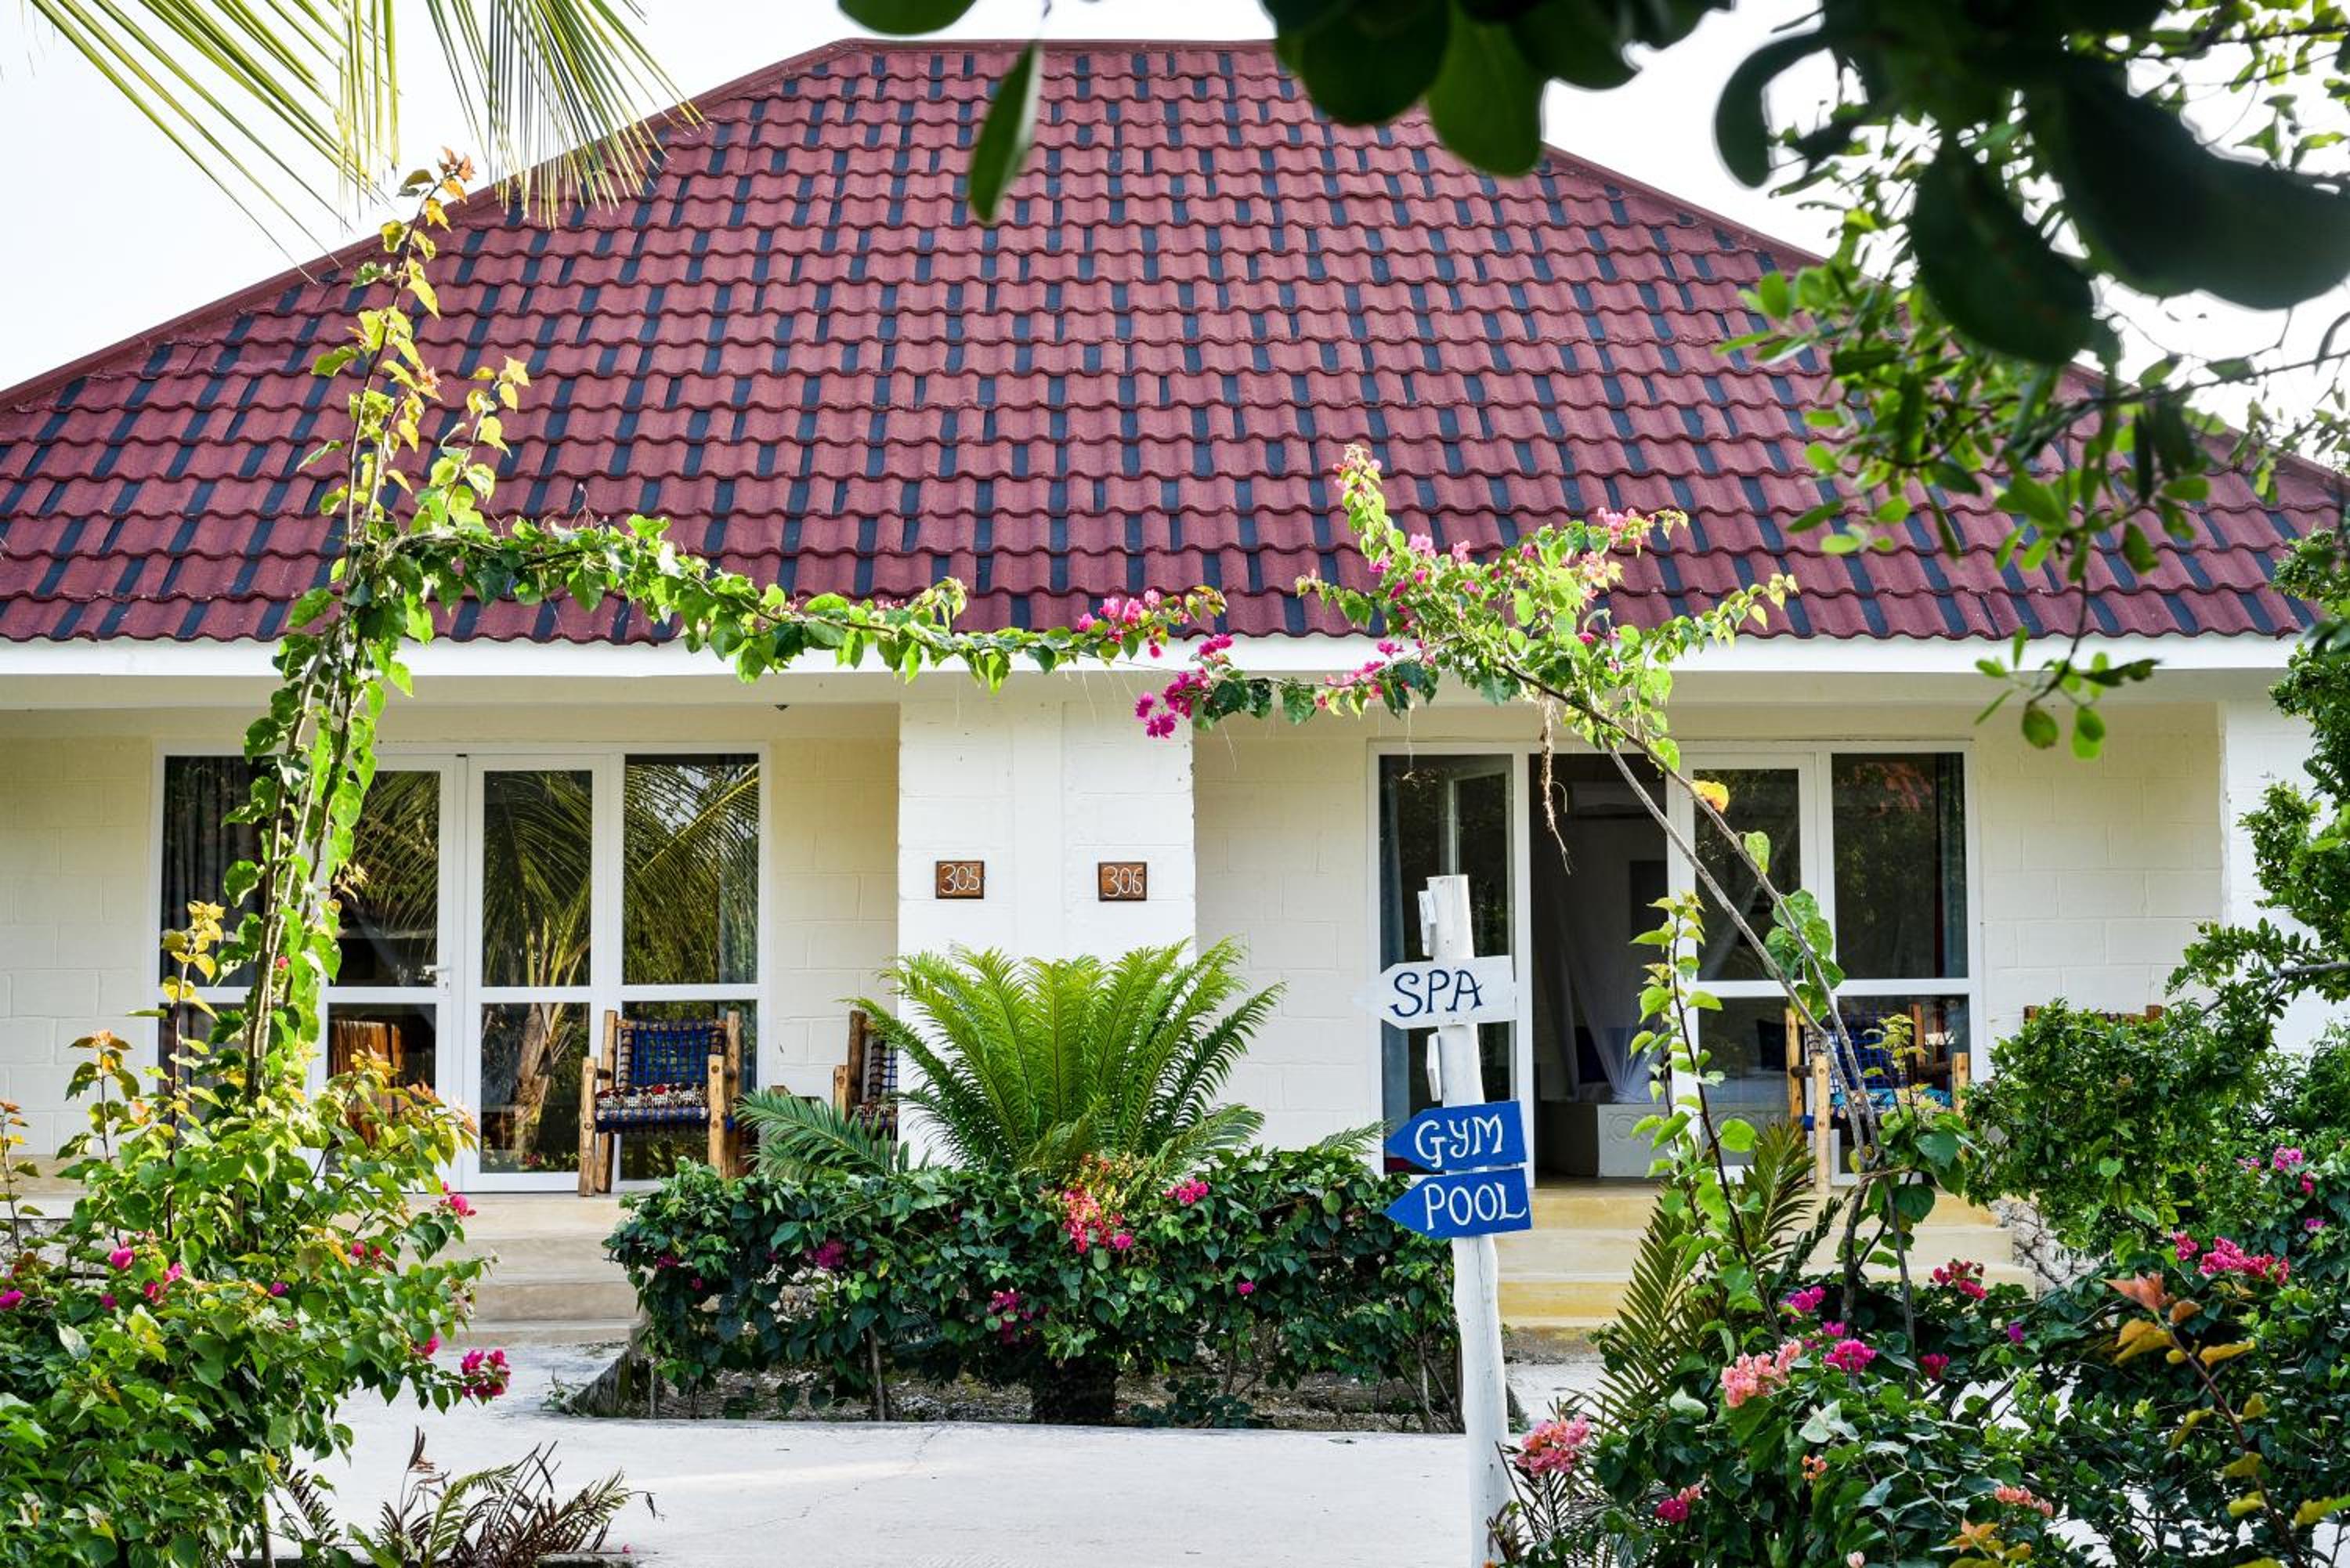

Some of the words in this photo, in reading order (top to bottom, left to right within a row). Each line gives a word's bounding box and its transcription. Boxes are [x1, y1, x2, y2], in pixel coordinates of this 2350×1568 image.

[941, 864, 980, 894] 305
[1102, 865, 1143, 897] 306
[1389, 969, 1483, 1017] SPA
[1415, 1113, 1503, 1168] GYM
[1423, 1182, 1527, 1230] POOL
